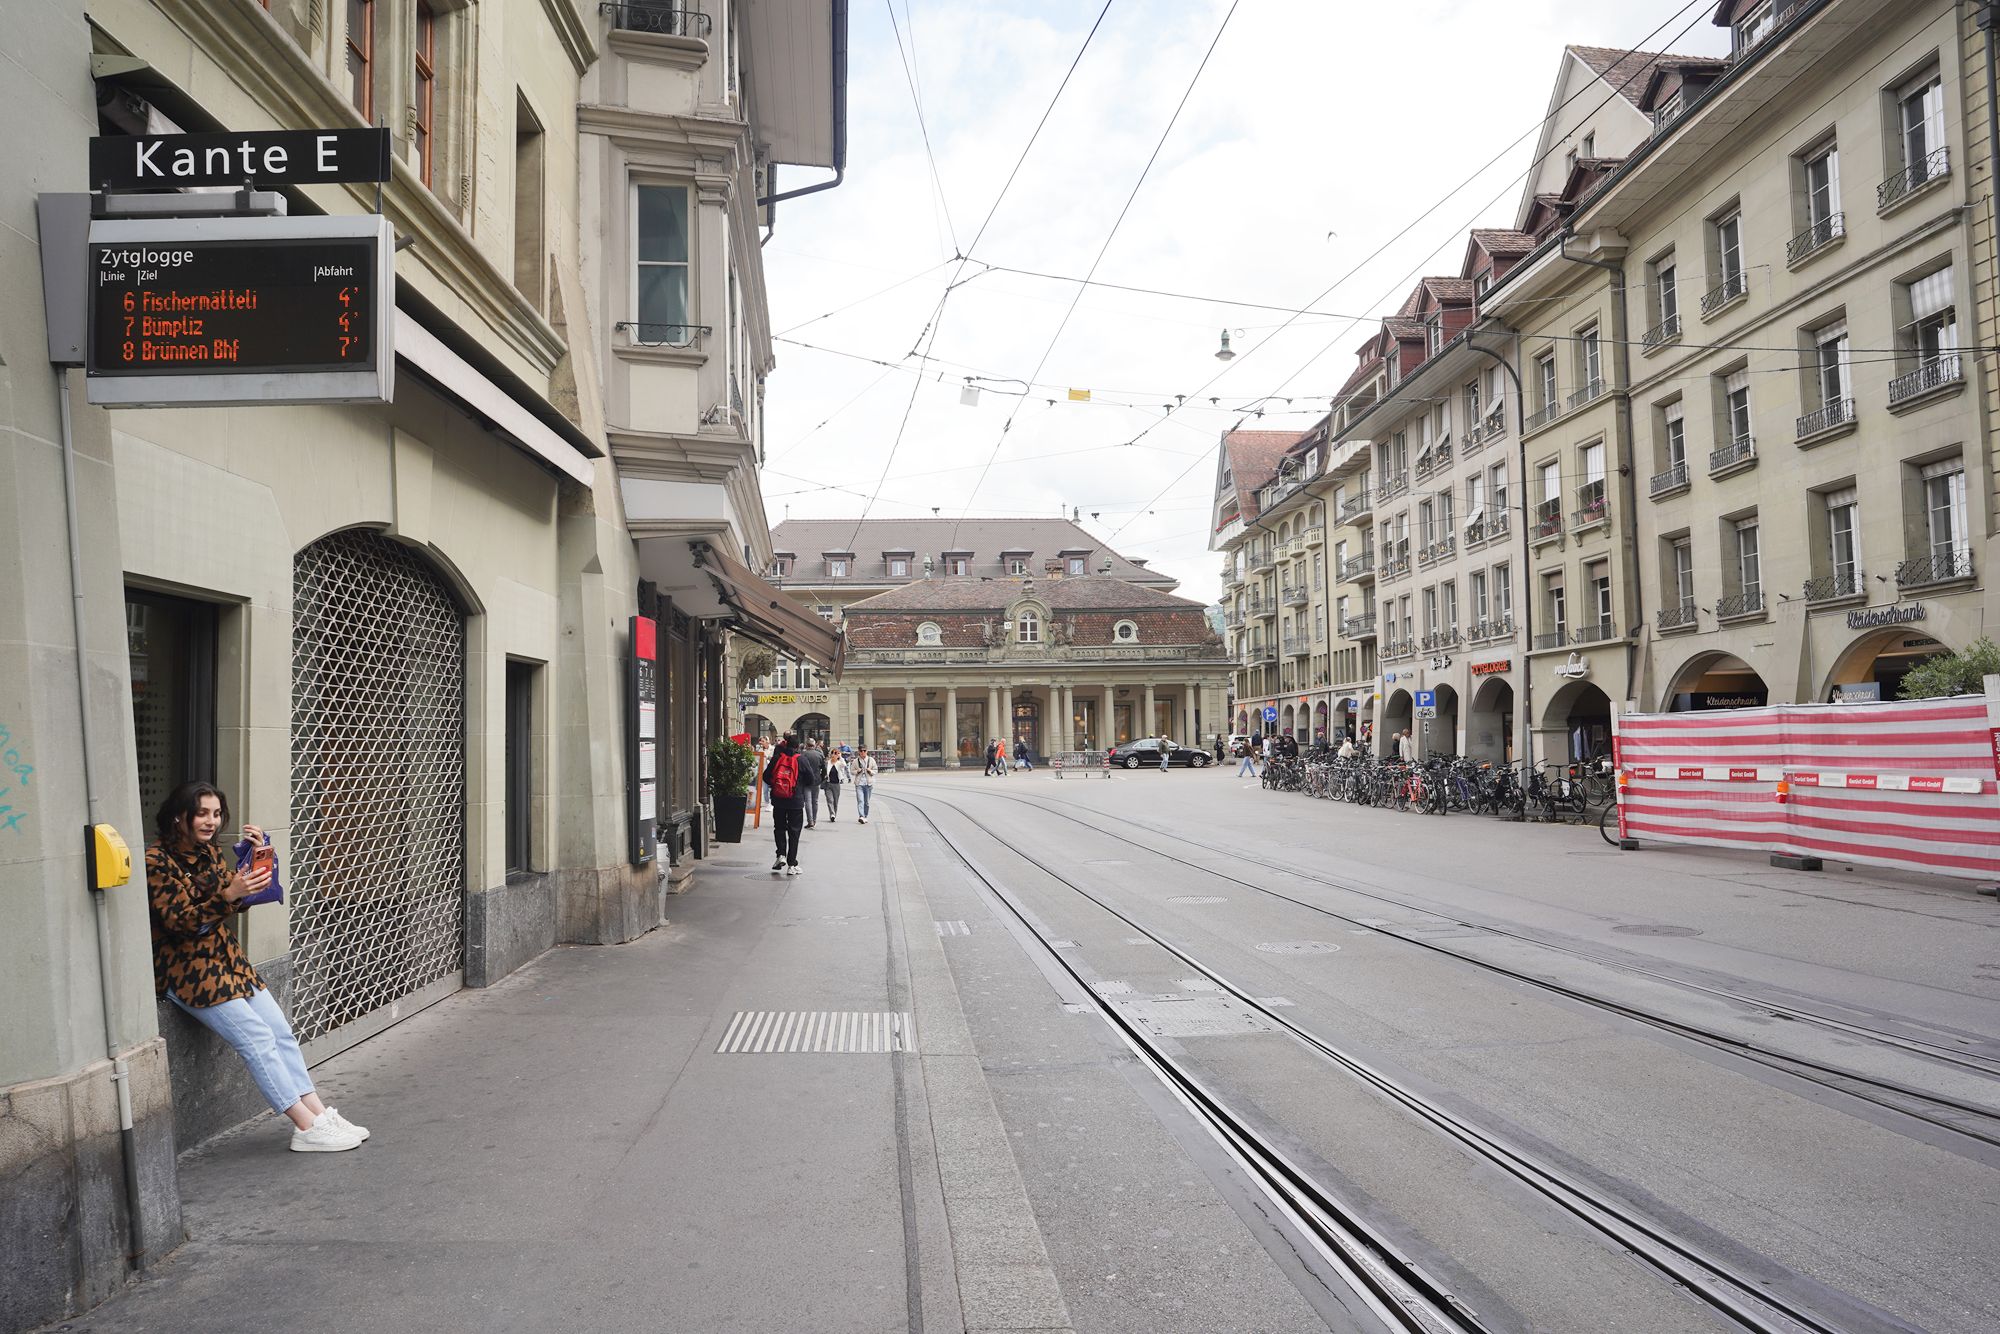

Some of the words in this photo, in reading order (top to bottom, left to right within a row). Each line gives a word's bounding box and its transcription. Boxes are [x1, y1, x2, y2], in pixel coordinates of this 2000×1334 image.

[136, 140, 288, 177] Kante
[316, 135, 339, 172] E
[101, 247, 194, 268] Zytglogge
[103, 270, 126, 281] Linie
[140, 269, 158, 281] Ziel
[317, 265, 353, 277] Abfahrt
[123, 291, 135, 312] 6
[142, 289, 257, 312] Fischermätteli
[123, 316, 135, 337] 7
[142, 315, 203, 339] Bümpliz
[122, 341, 135, 361] 8
[141, 340, 209, 361] Brünnen
[213, 338, 240, 362] Bhf
[1847, 602, 1927, 629] Kleiderschrank
[799, 695, 829, 704] VIDEO
[1419, 693, 1431, 706] P
